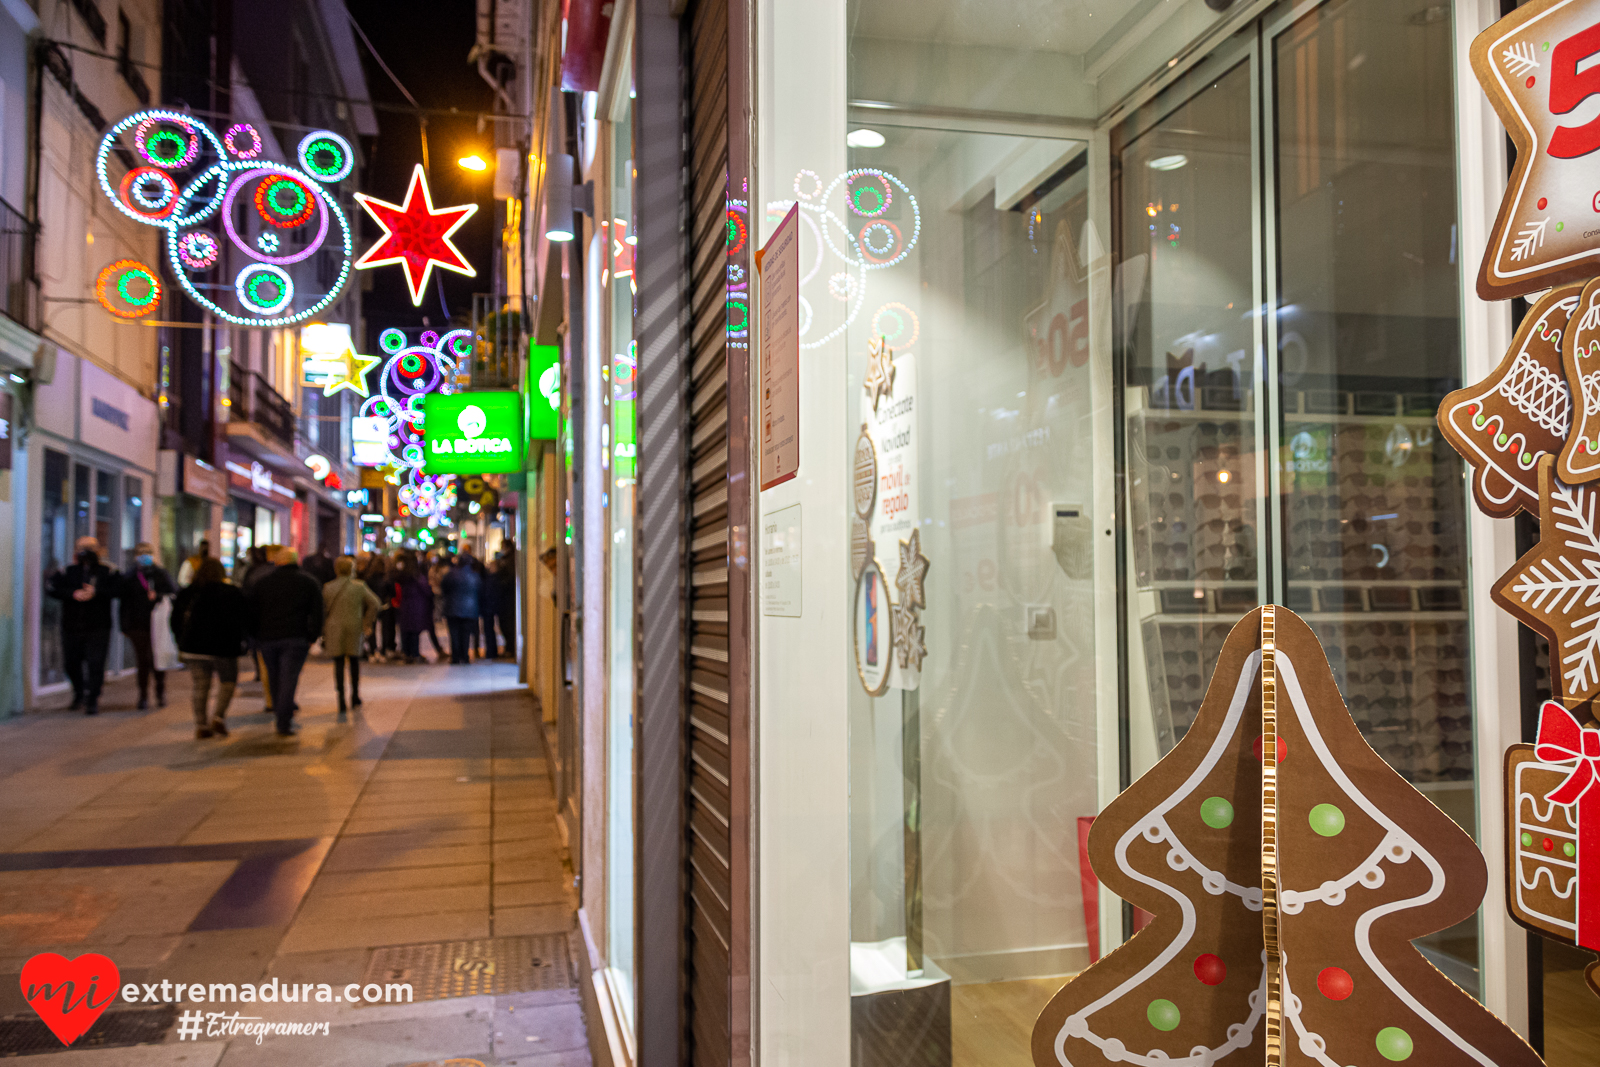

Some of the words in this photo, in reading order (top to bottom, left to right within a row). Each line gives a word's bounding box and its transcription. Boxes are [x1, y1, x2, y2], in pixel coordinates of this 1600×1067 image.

[431, 439, 453, 454] LA
[454, 438, 512, 454] BOTICA
[881, 488, 909, 520] regalo
